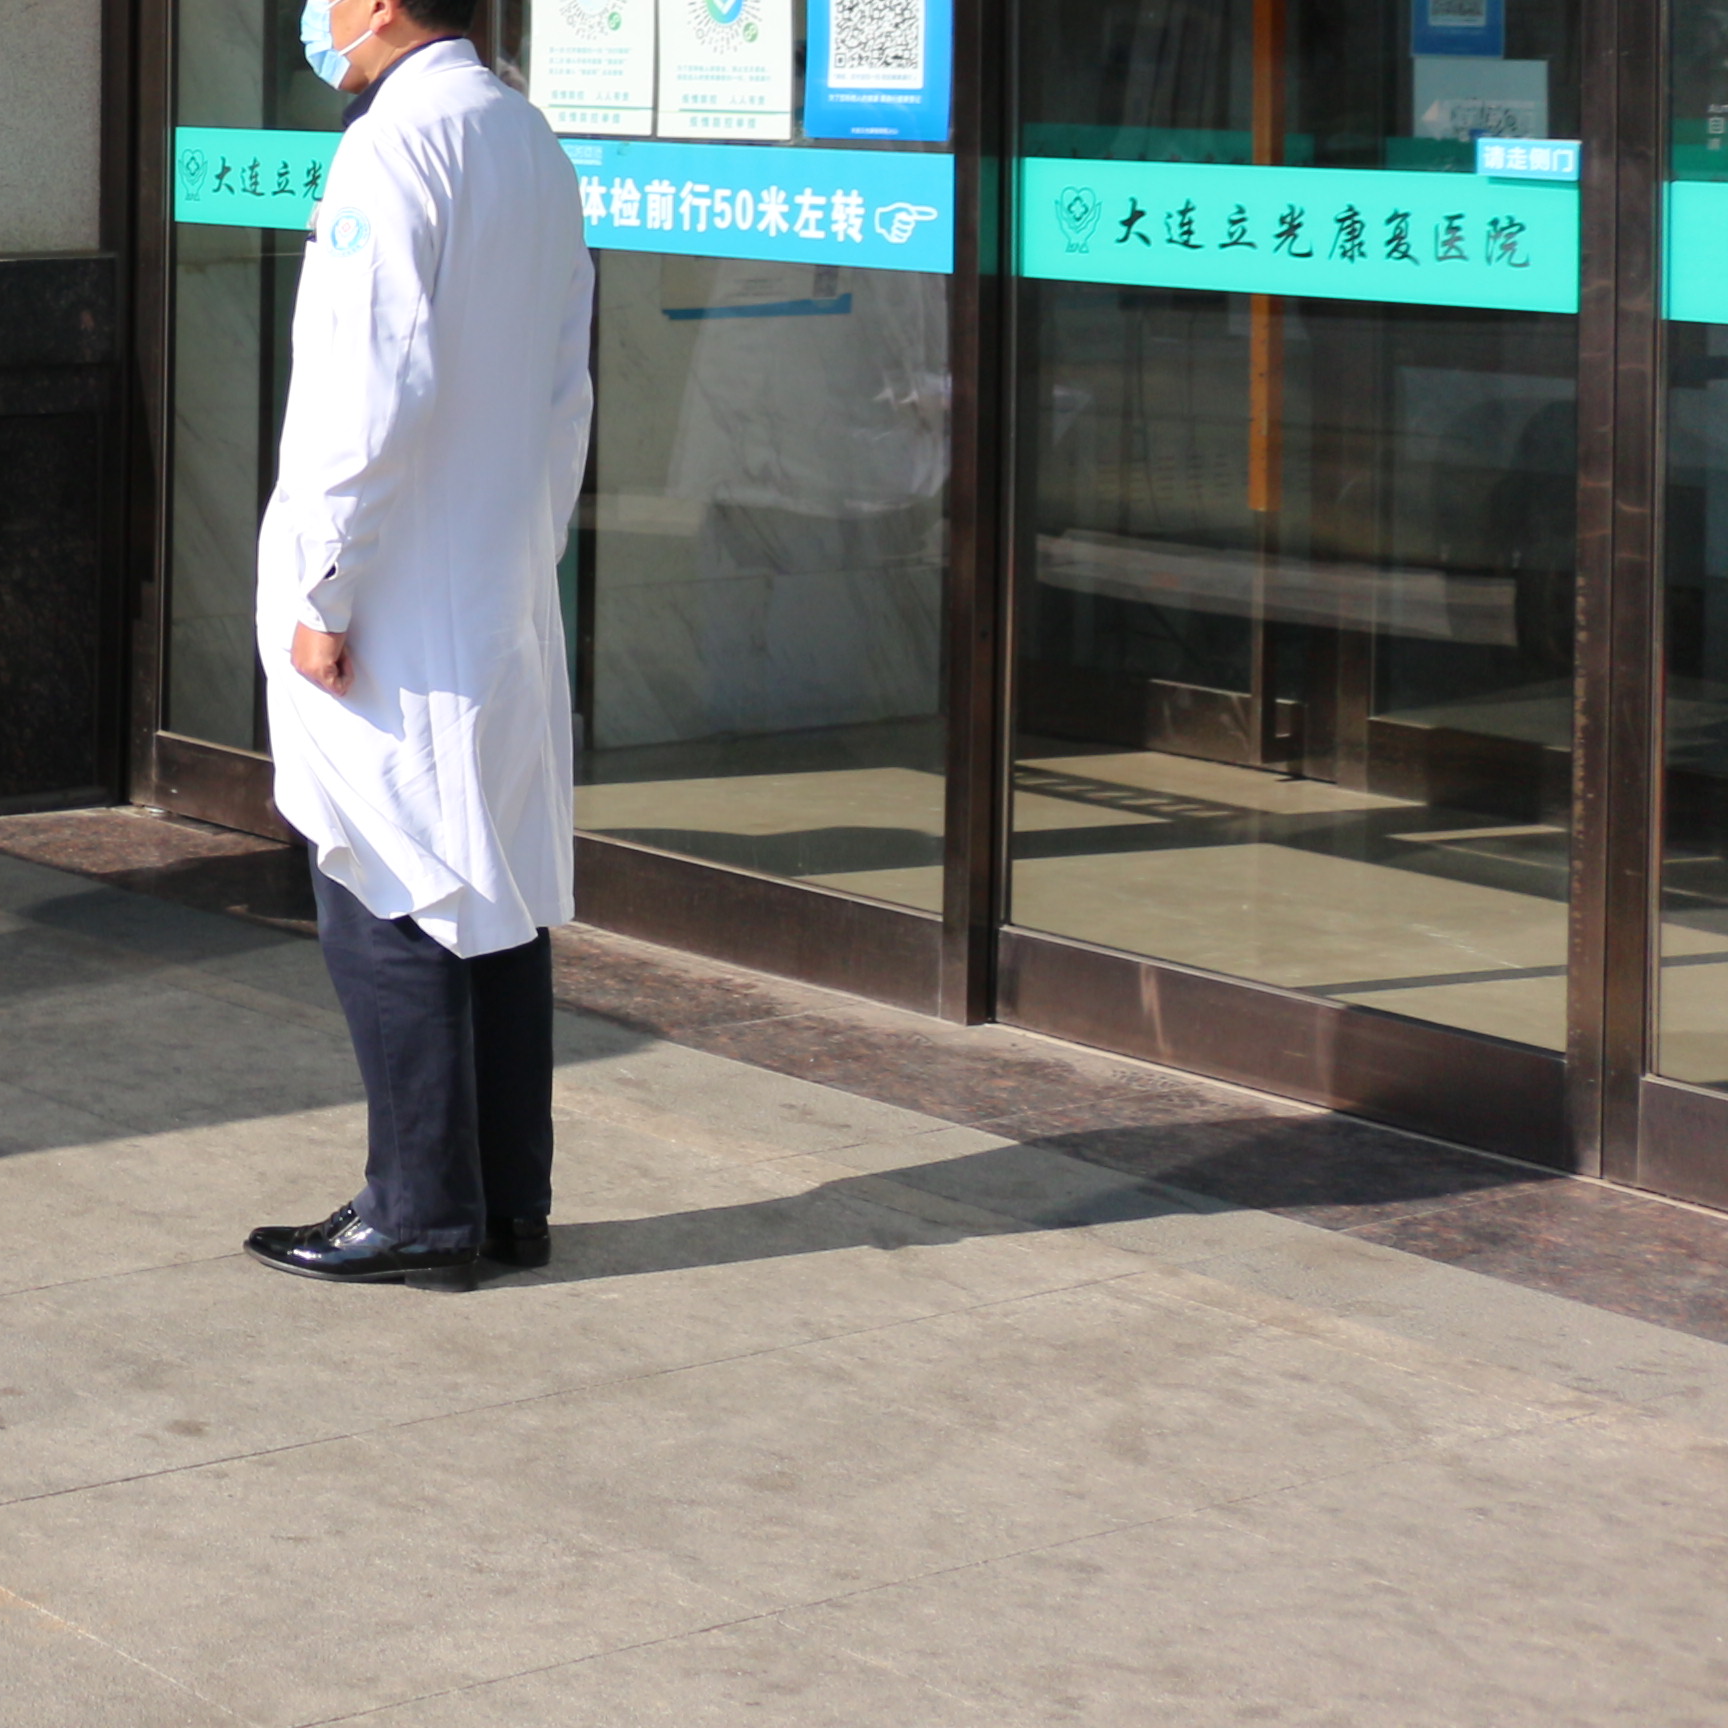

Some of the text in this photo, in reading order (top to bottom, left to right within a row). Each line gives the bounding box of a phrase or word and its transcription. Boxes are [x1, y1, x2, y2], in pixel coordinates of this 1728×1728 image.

[212, 156, 323, 202] 大连立光
[1482, 146, 1575, 173] 请走侧门
[578, 175, 866, 244] 体检前行50米左转
[1113, 196, 1532, 268] 大连立光康复医院
